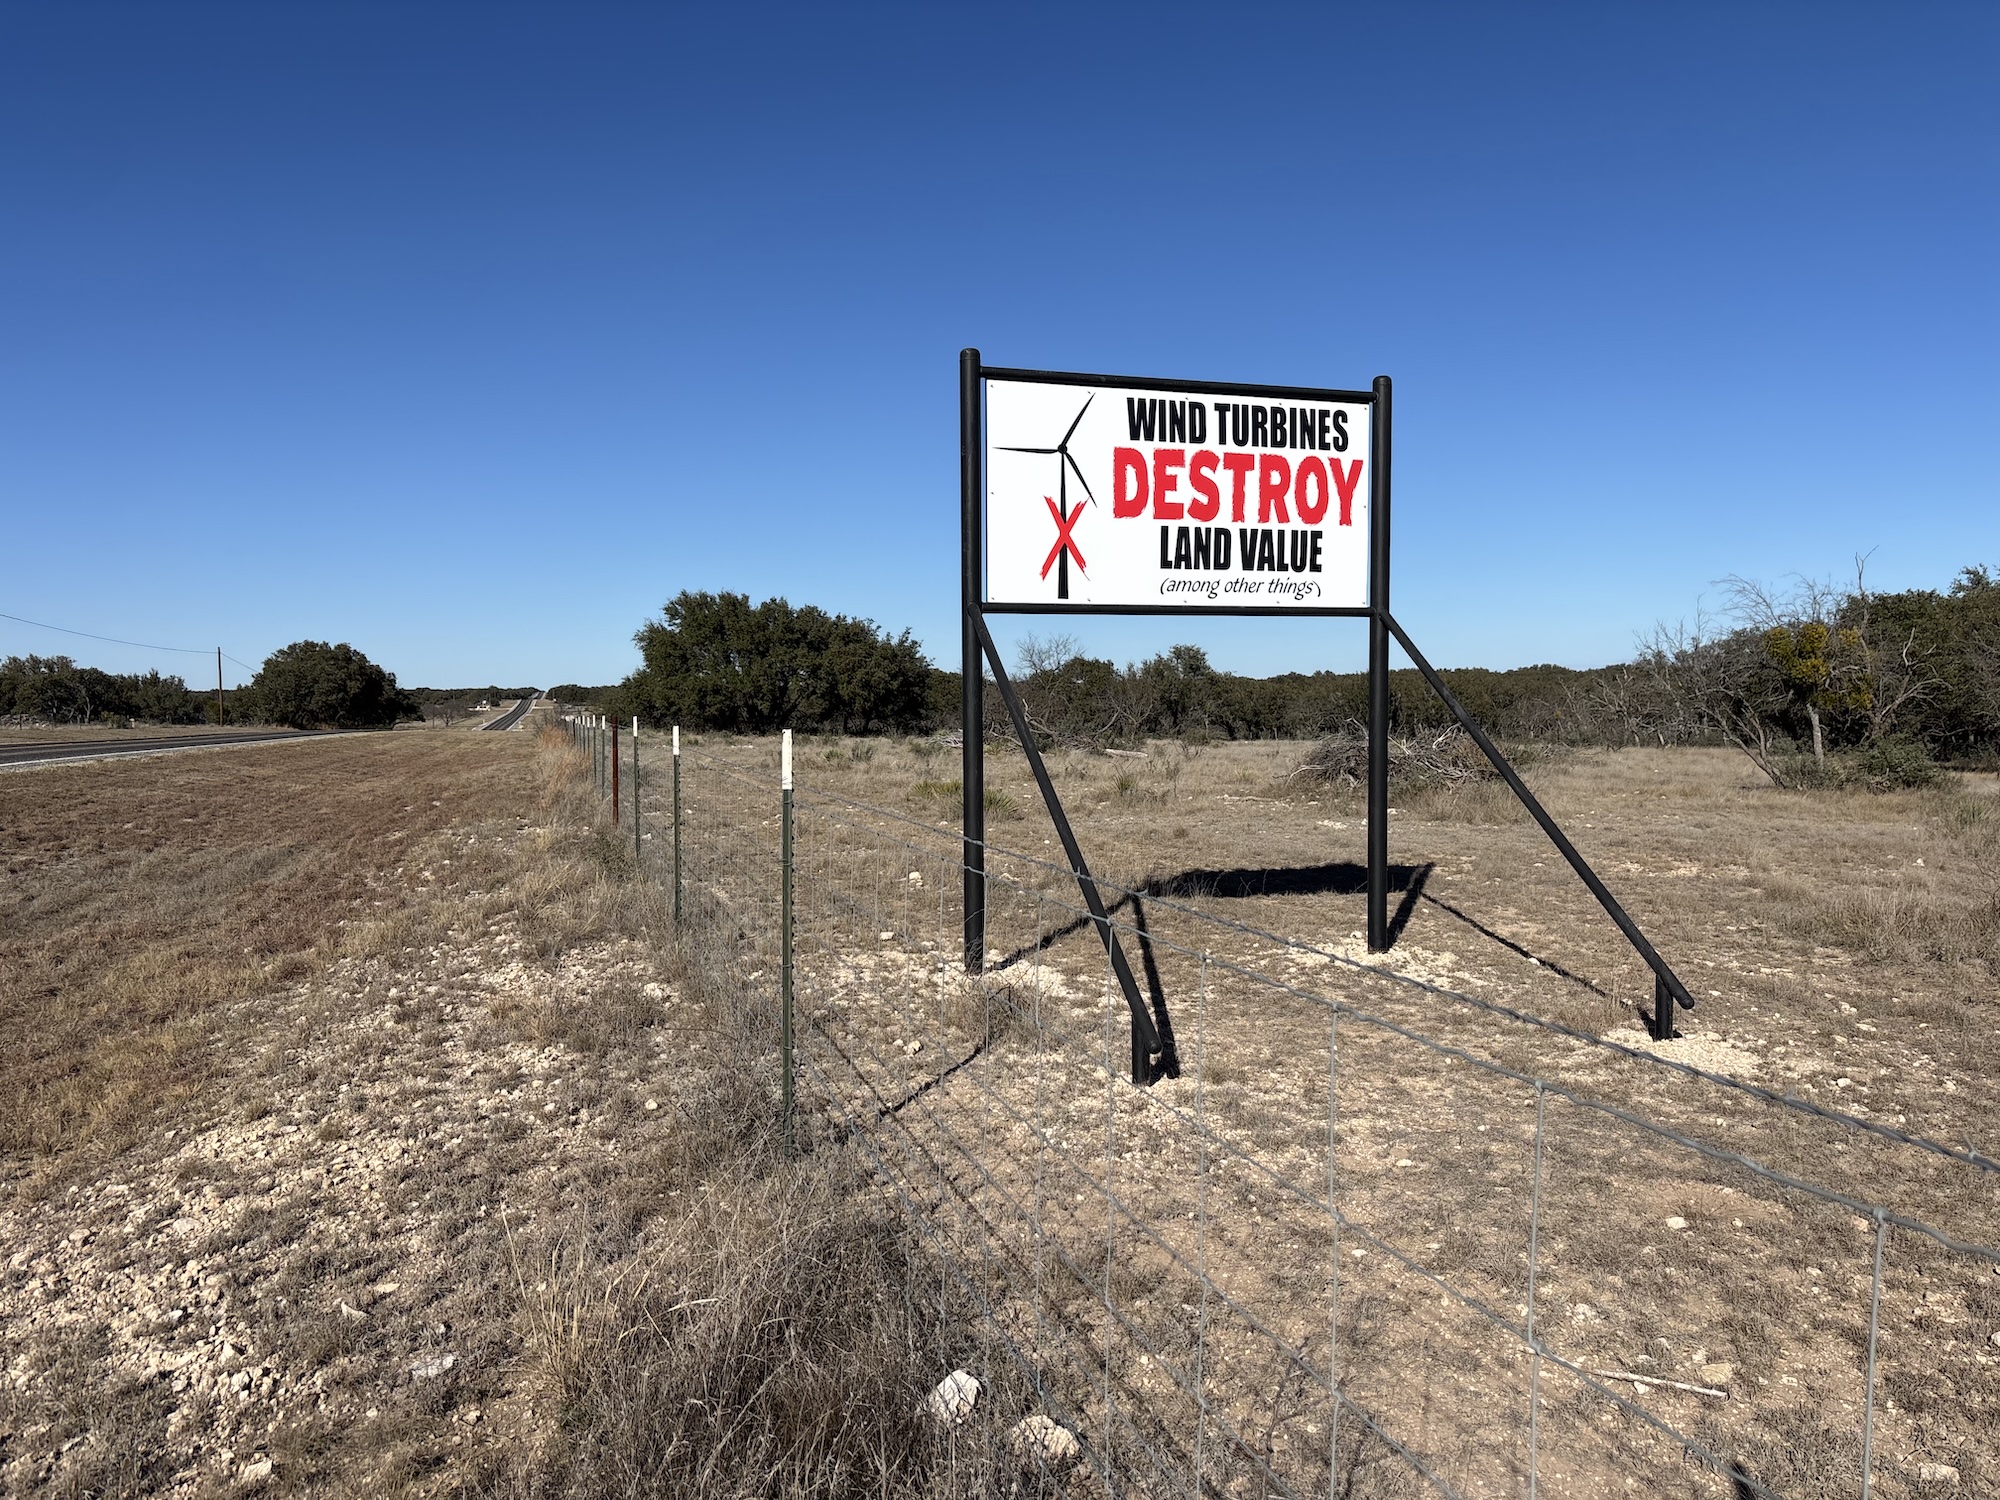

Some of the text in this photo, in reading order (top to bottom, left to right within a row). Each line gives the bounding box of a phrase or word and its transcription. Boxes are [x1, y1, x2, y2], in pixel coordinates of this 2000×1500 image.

[1126, 397, 1349, 452] WIND TURBINES
[1113, 446, 1364, 526] DESTROY
[1160, 525, 1323, 573] LAND VALUE
[1159, 576, 1322, 600] (among other things)
